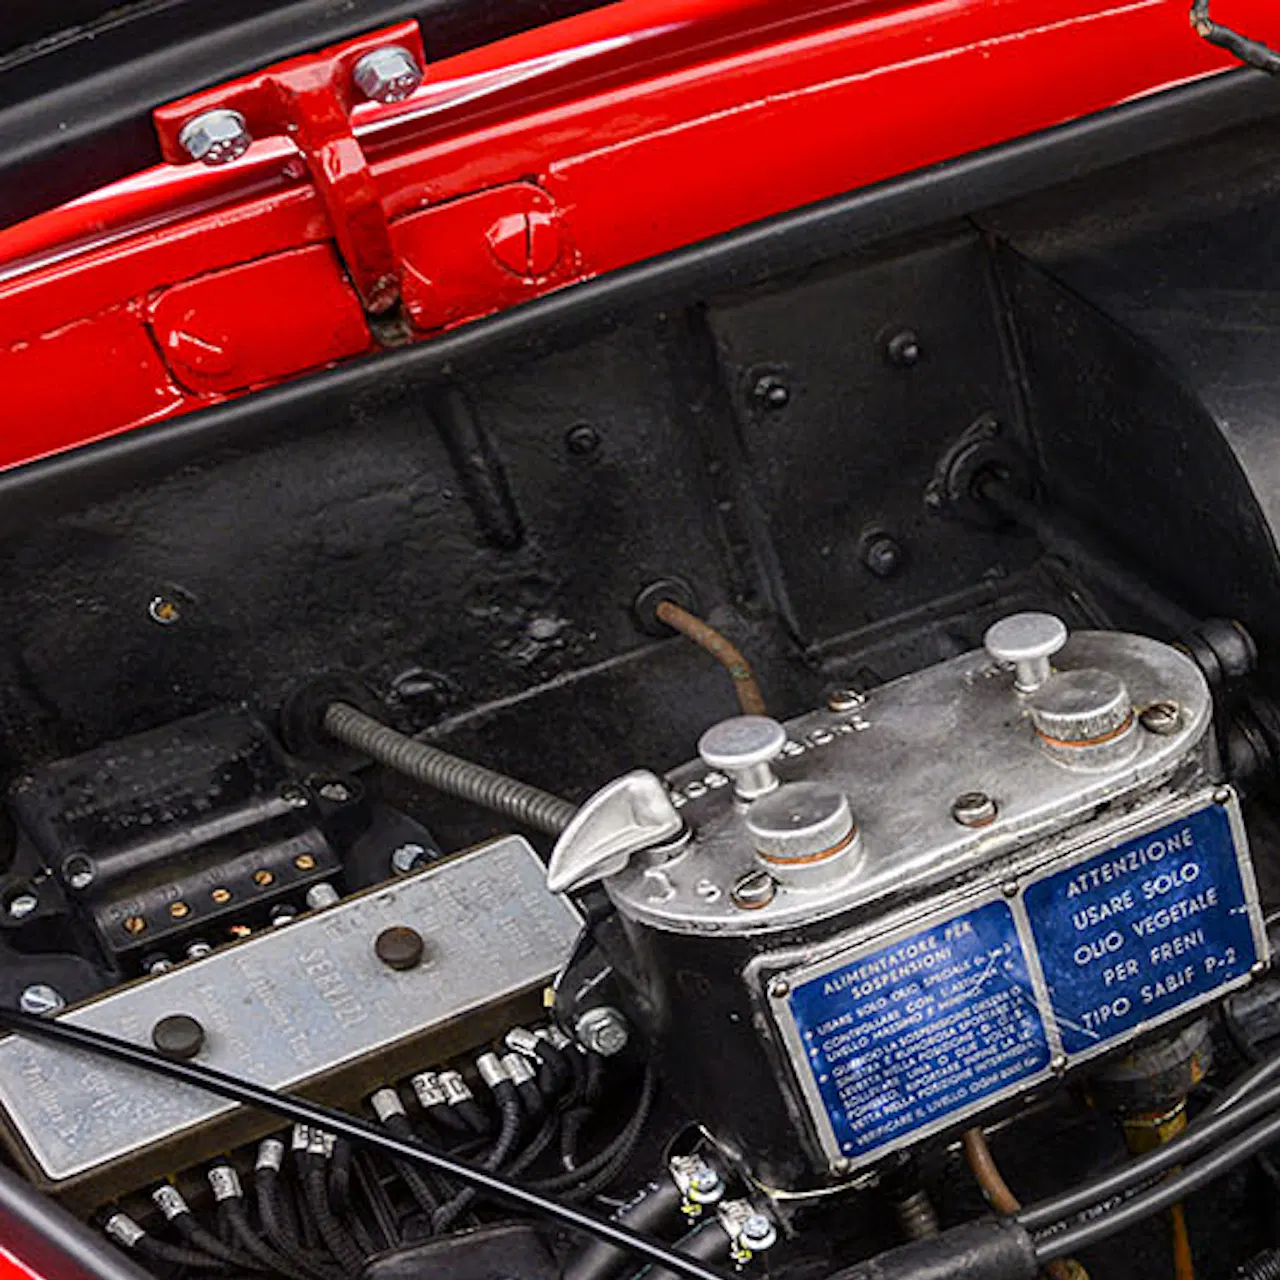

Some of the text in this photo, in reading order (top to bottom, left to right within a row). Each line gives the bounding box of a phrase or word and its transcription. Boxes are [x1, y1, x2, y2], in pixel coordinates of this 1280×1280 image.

[1068, 829, 1192, 898] ATTENZIONE
[1073, 863, 1199, 930] USARE SOLO
[825, 936, 938, 993] ALIMENTATORE
[944, 921, 973, 942] PER
[1074, 888, 1216, 965] OLIO VEGETALE
[1103, 930, 1204, 986] PER FRENI
[852, 947, 951, 999] SOSPENSIONI
[1082, 947, 1236, 1034] TIPO SABIF P-2
